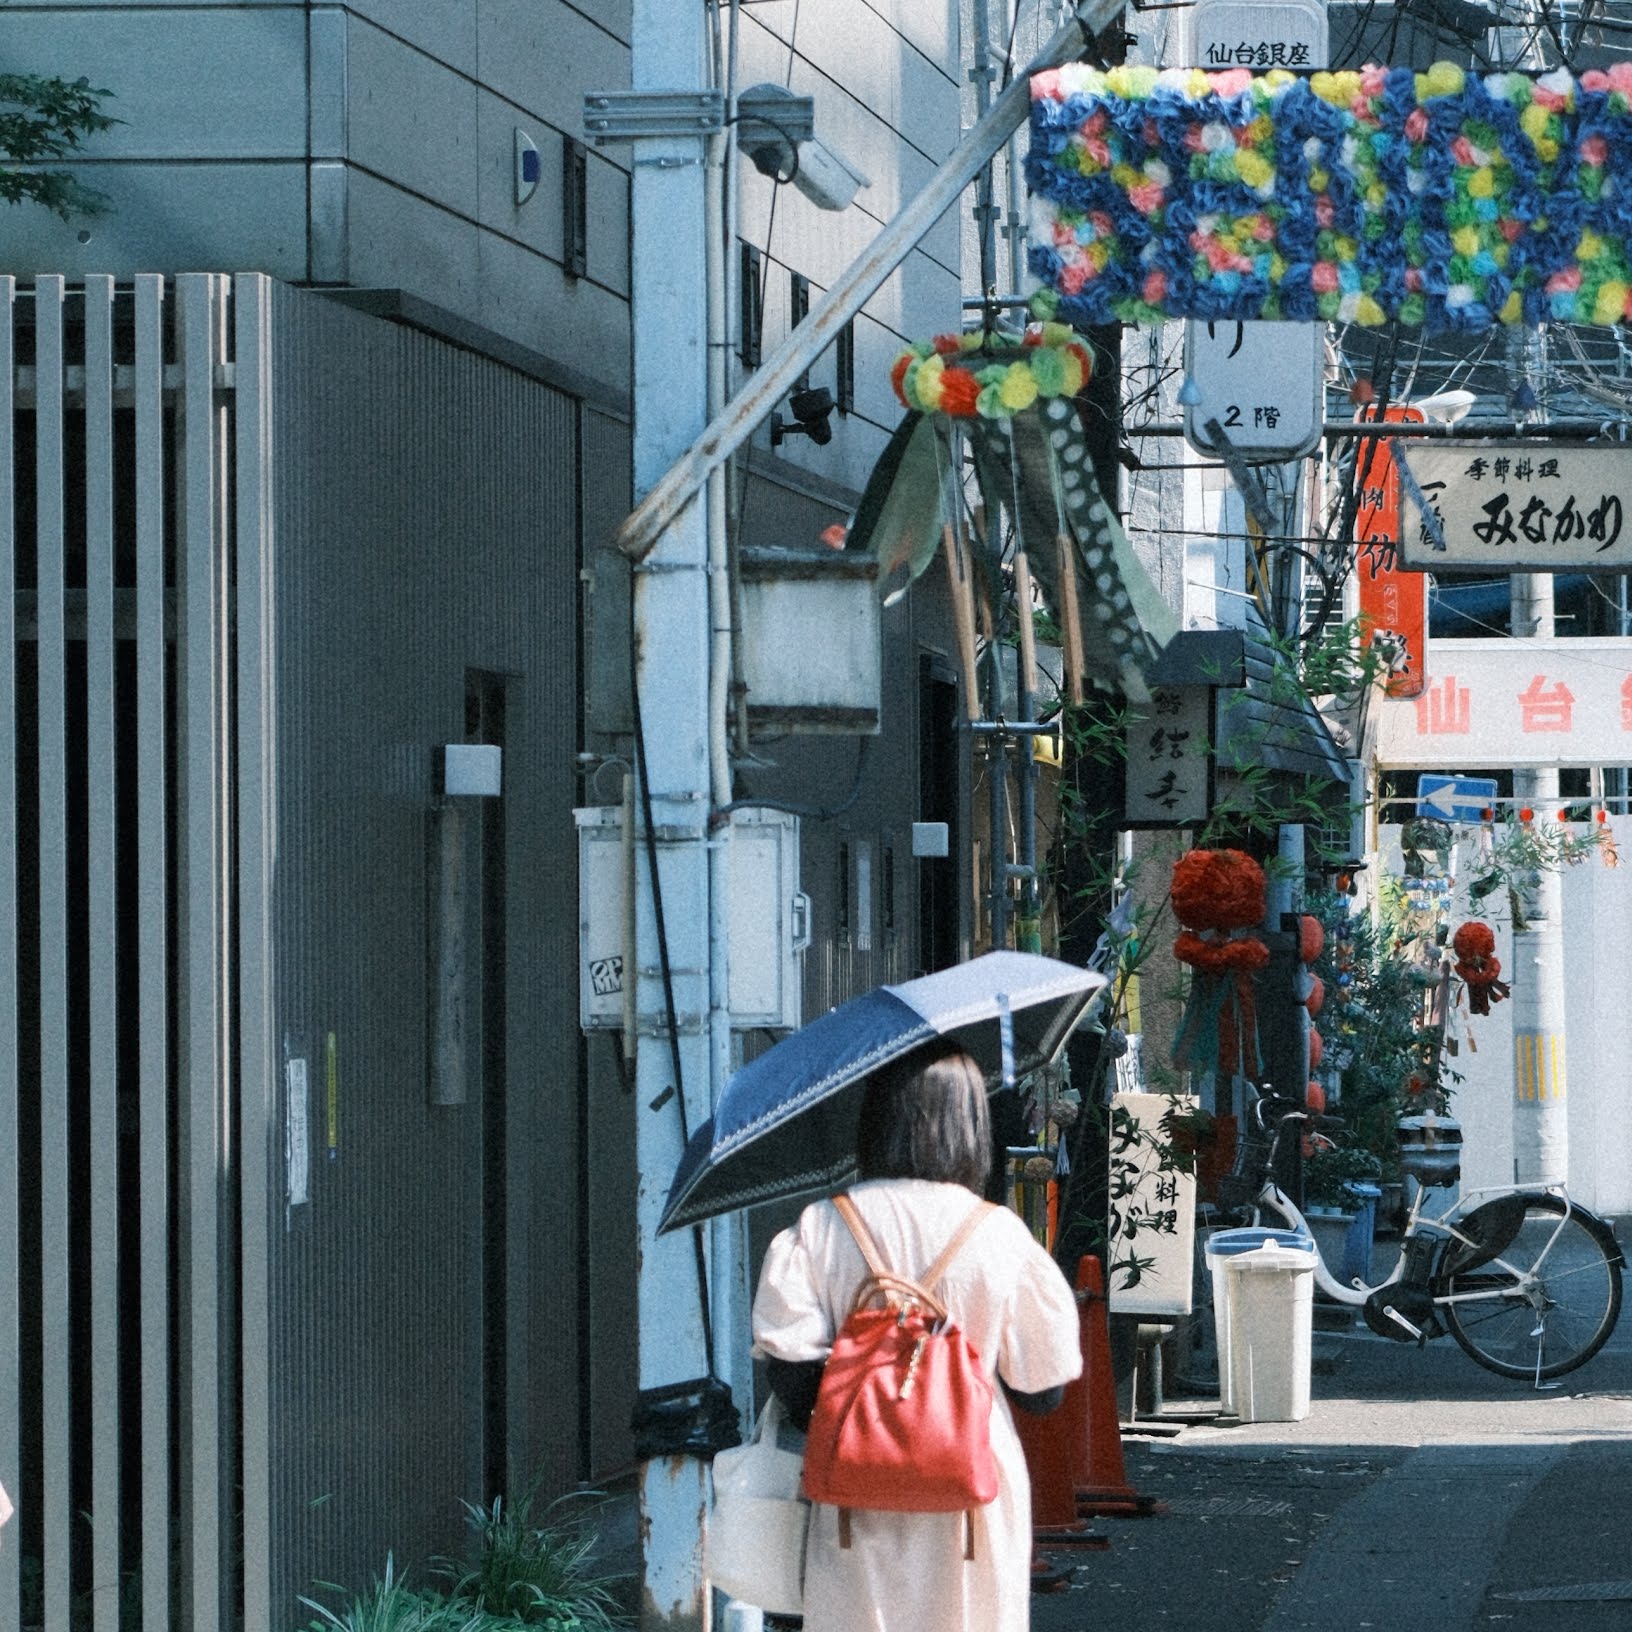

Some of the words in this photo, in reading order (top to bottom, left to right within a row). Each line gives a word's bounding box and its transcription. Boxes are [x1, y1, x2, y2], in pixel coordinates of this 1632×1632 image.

[1206, 41, 1311, 67] 仙台銀座
[1464, 456, 1562, 484] 季節料理
[1473, 492, 1623, 553] みなかわ
